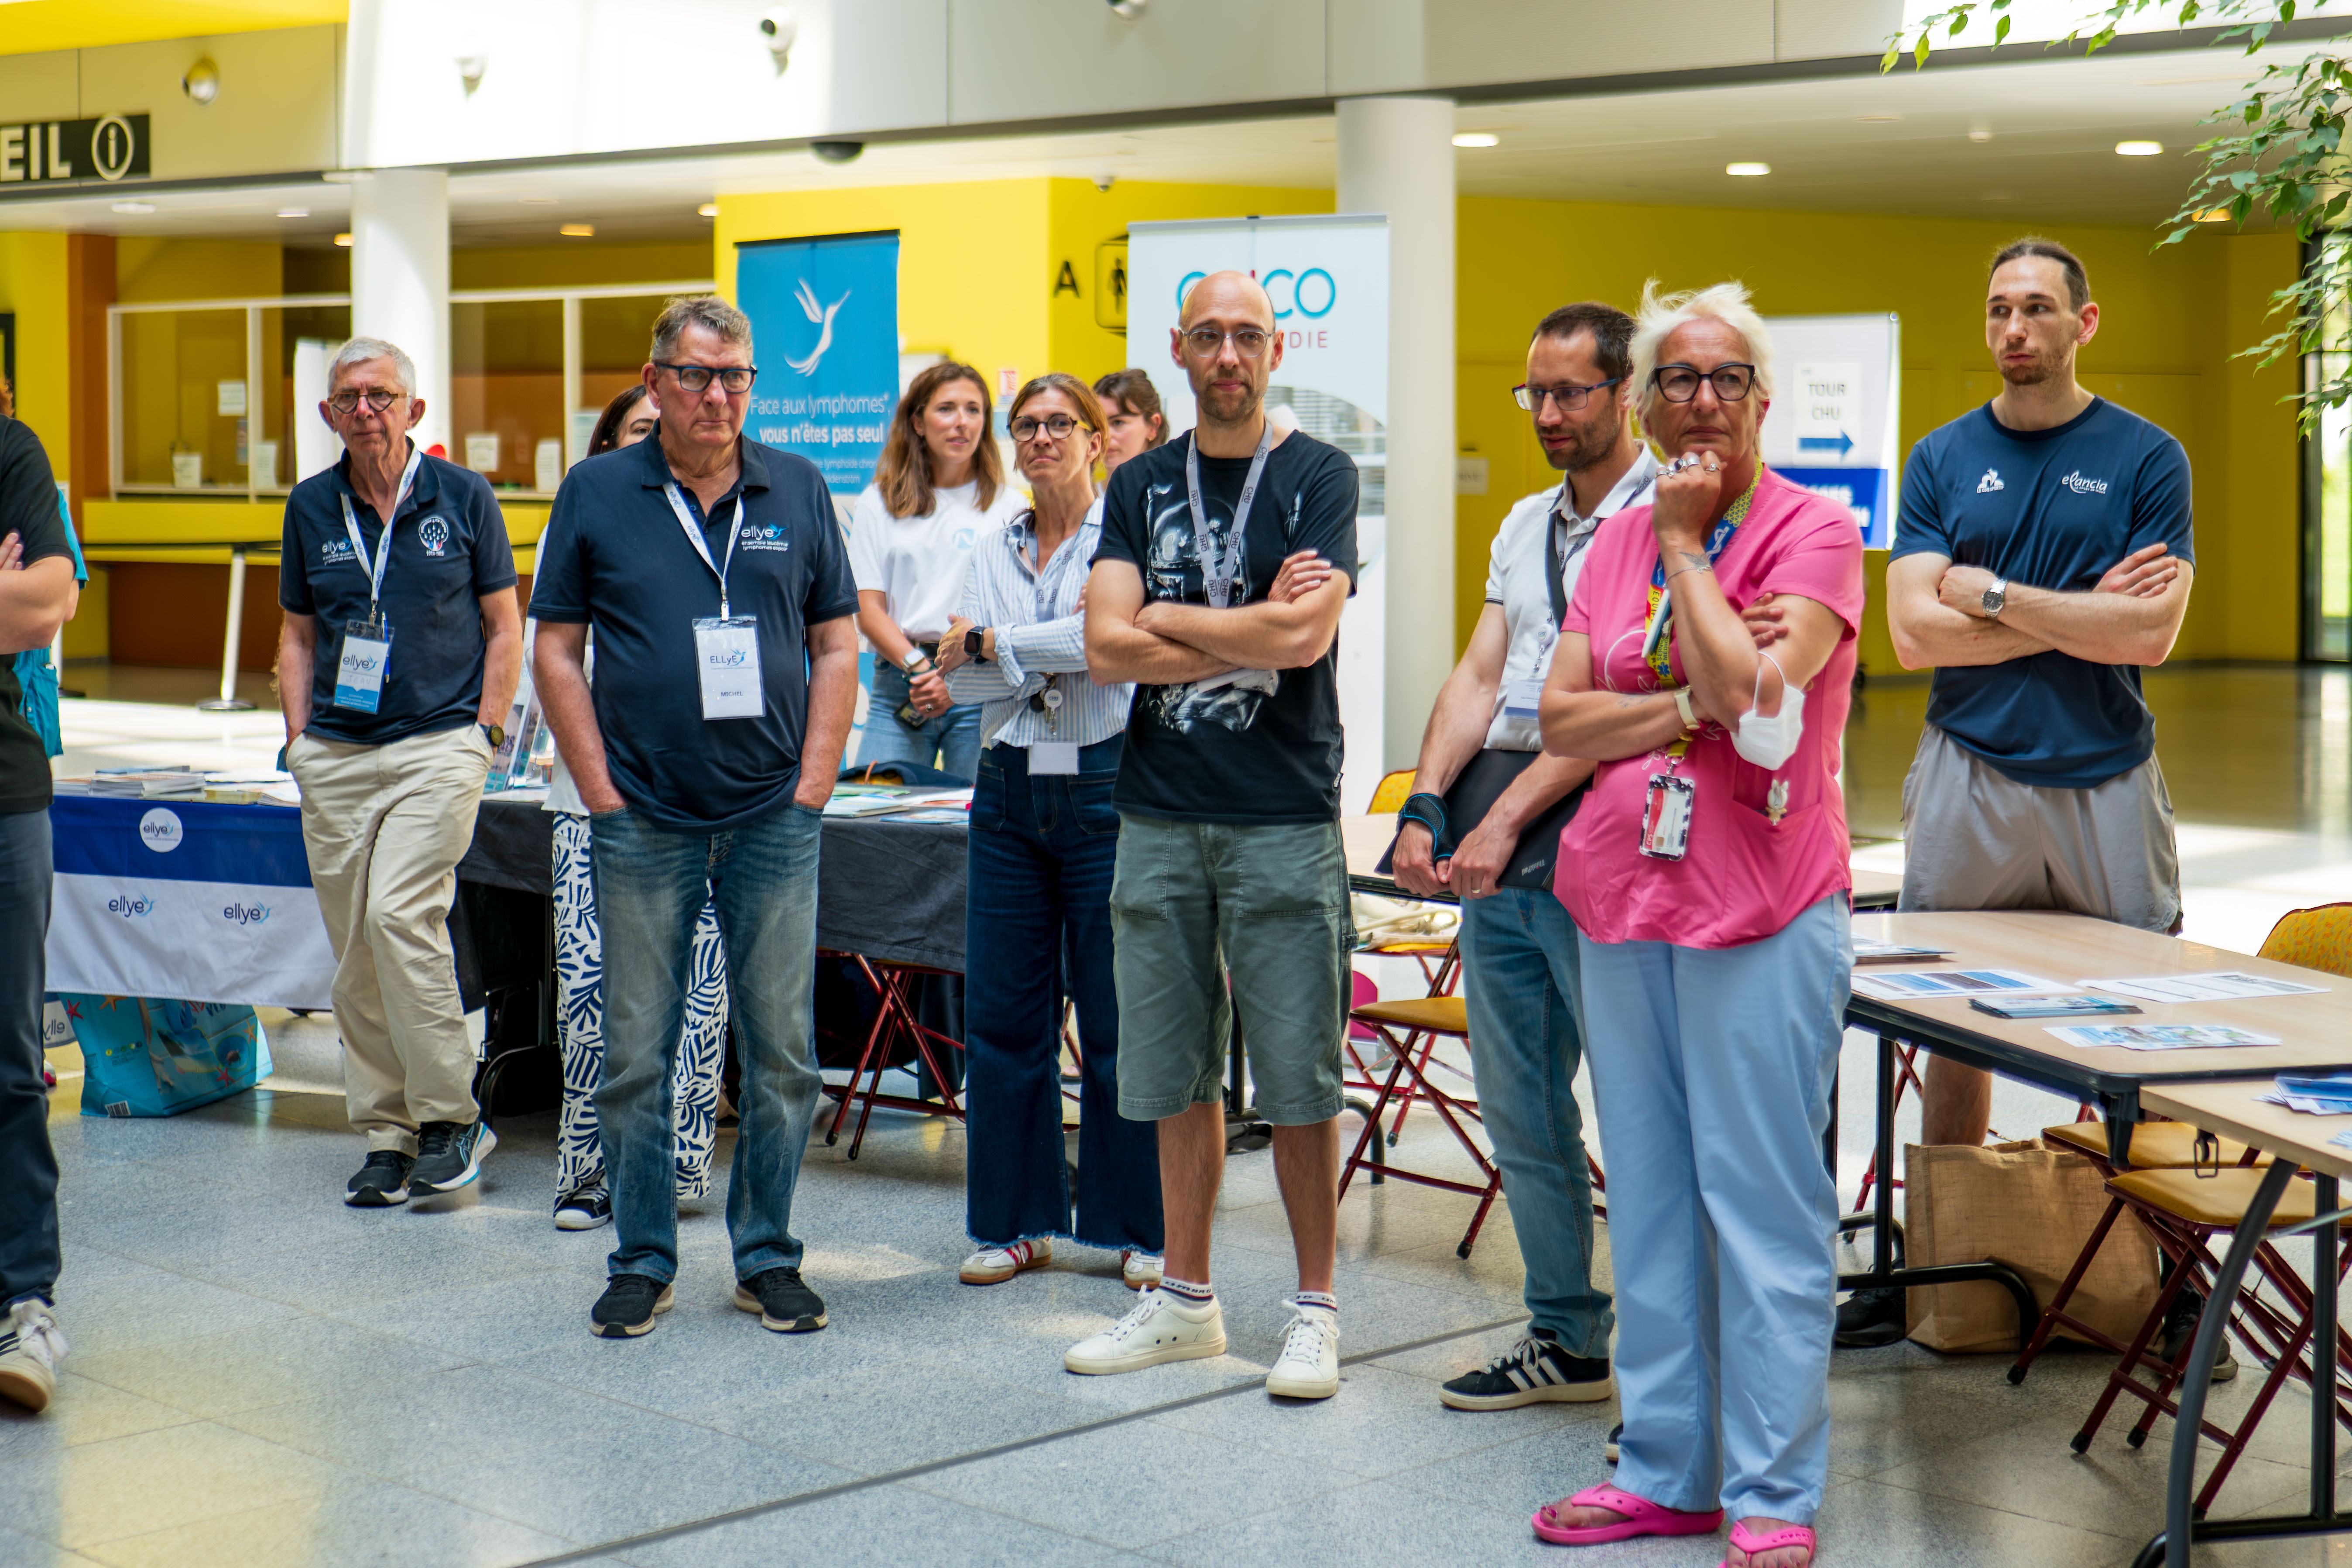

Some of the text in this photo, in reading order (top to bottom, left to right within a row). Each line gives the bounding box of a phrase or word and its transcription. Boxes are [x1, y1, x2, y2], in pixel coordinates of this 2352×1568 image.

[1054, 260, 1080, 299] A
[1289, 331, 1328, 348] DIE
[1809, 383, 1846, 396] TOUR
[750, 397, 779, 415] Face
[782, 401, 806, 415] aux
[1812, 406, 1842, 420] CHU
[759, 426, 788, 443] vous
[832, 427, 854, 447] pas
[857, 422, 884, 443] seul
[1639, 476, 1649, 492] CHU
[2062, 470, 2107, 494] elancia
[1244, 486, 1254, 504] CHU
[741, 525, 774, 540] ellye
[1231, 532, 1240, 549] CHU
[322, 540, 346, 554] ellye
[1199, 535, 1207, 552] CHU
[1208, 579, 1217, 597] CHU
[343, 654, 369, 671] ellye
[710, 655, 737, 665] ELLyE
[345, 675, 371, 686] JEAN
[144, 821, 168, 837] ellye
[1522, 859, 1545, 876] ThinkPad
[109, 895, 144, 917] ellye
[224, 902, 261, 925] ellye
